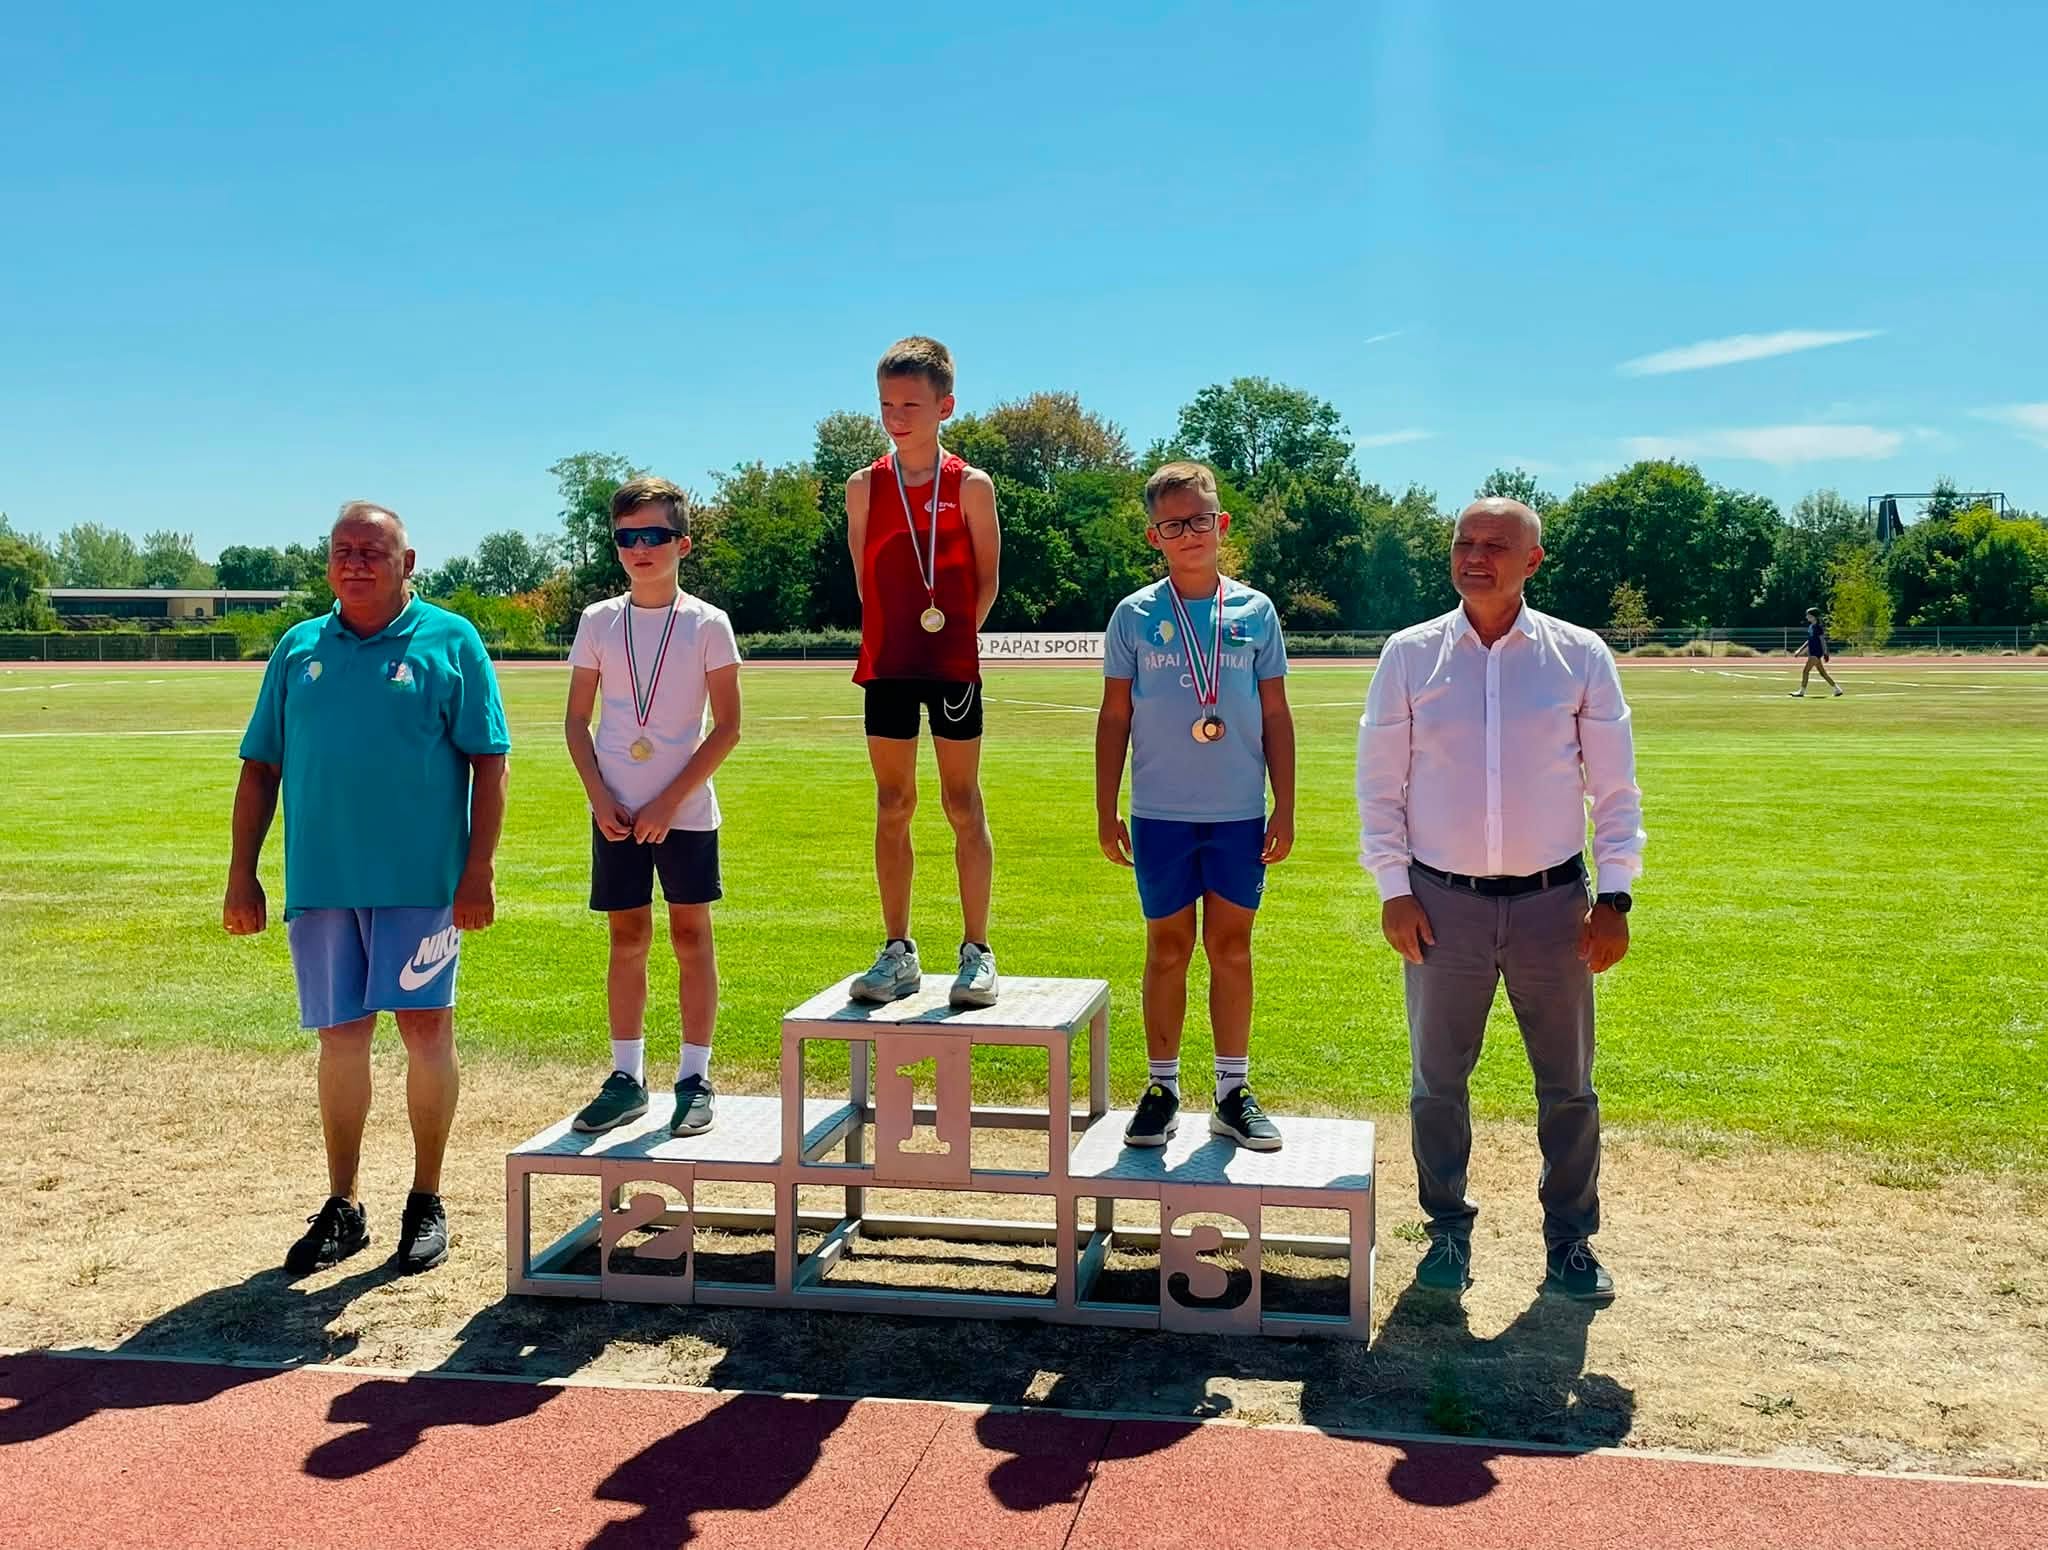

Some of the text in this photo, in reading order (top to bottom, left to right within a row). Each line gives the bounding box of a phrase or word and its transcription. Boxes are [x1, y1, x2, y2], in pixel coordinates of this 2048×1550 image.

[1044, 639, 1099, 653] SPORT
[895, 1056, 951, 1155] 1
[607, 1179, 689, 1277] 2
[1167, 1211, 1253, 1310] 3
